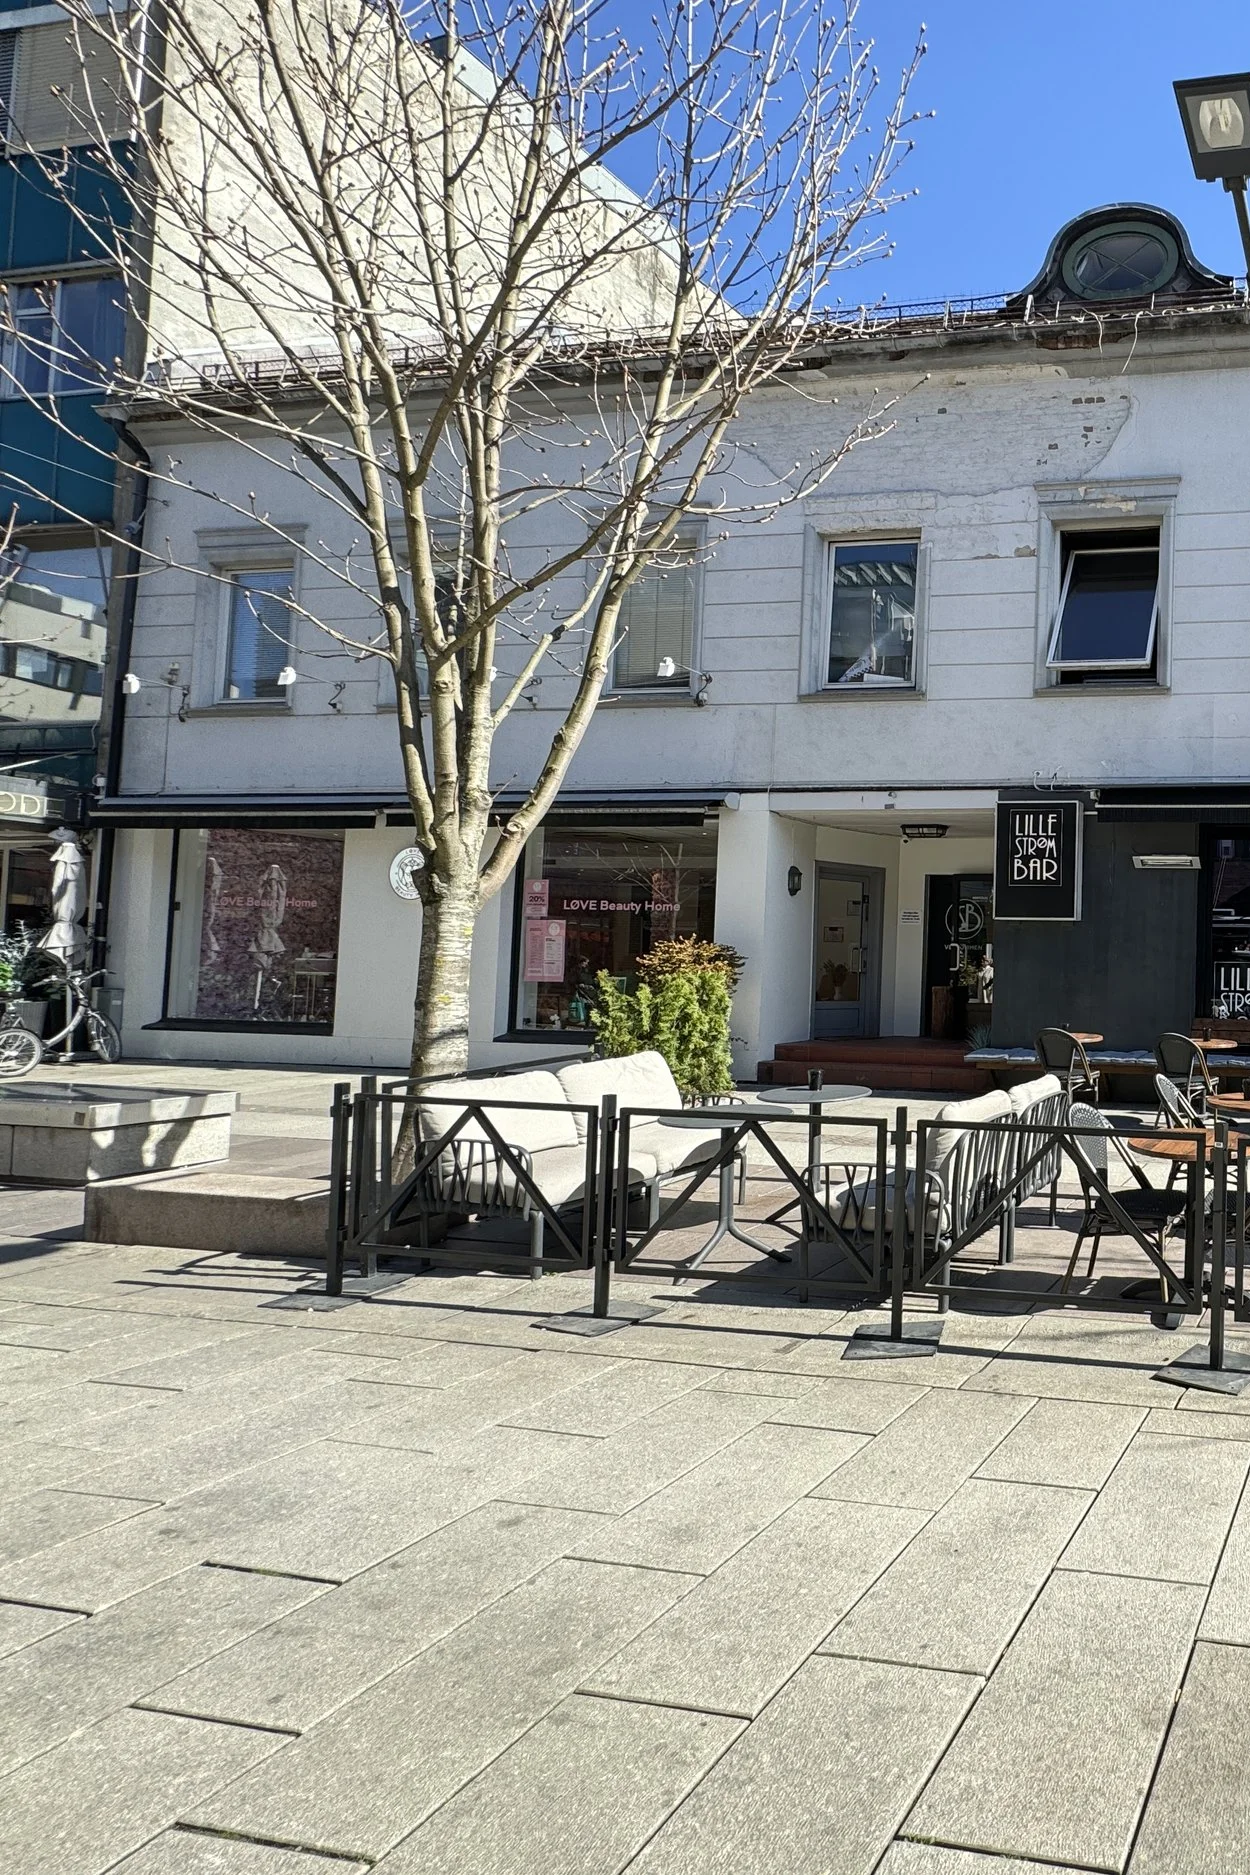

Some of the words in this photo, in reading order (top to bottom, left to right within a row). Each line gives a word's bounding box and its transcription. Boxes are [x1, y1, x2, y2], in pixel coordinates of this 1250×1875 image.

[1015, 814, 1057, 836] LILLE
[1014, 837, 1057, 857] STRØM
[1013, 858, 1058, 880] BAR
[285, 898, 318, 908] Home
[563, 900, 598, 910] LØVE
[600, 900, 641, 914] Beauty
[644, 900, 681, 911] Home
